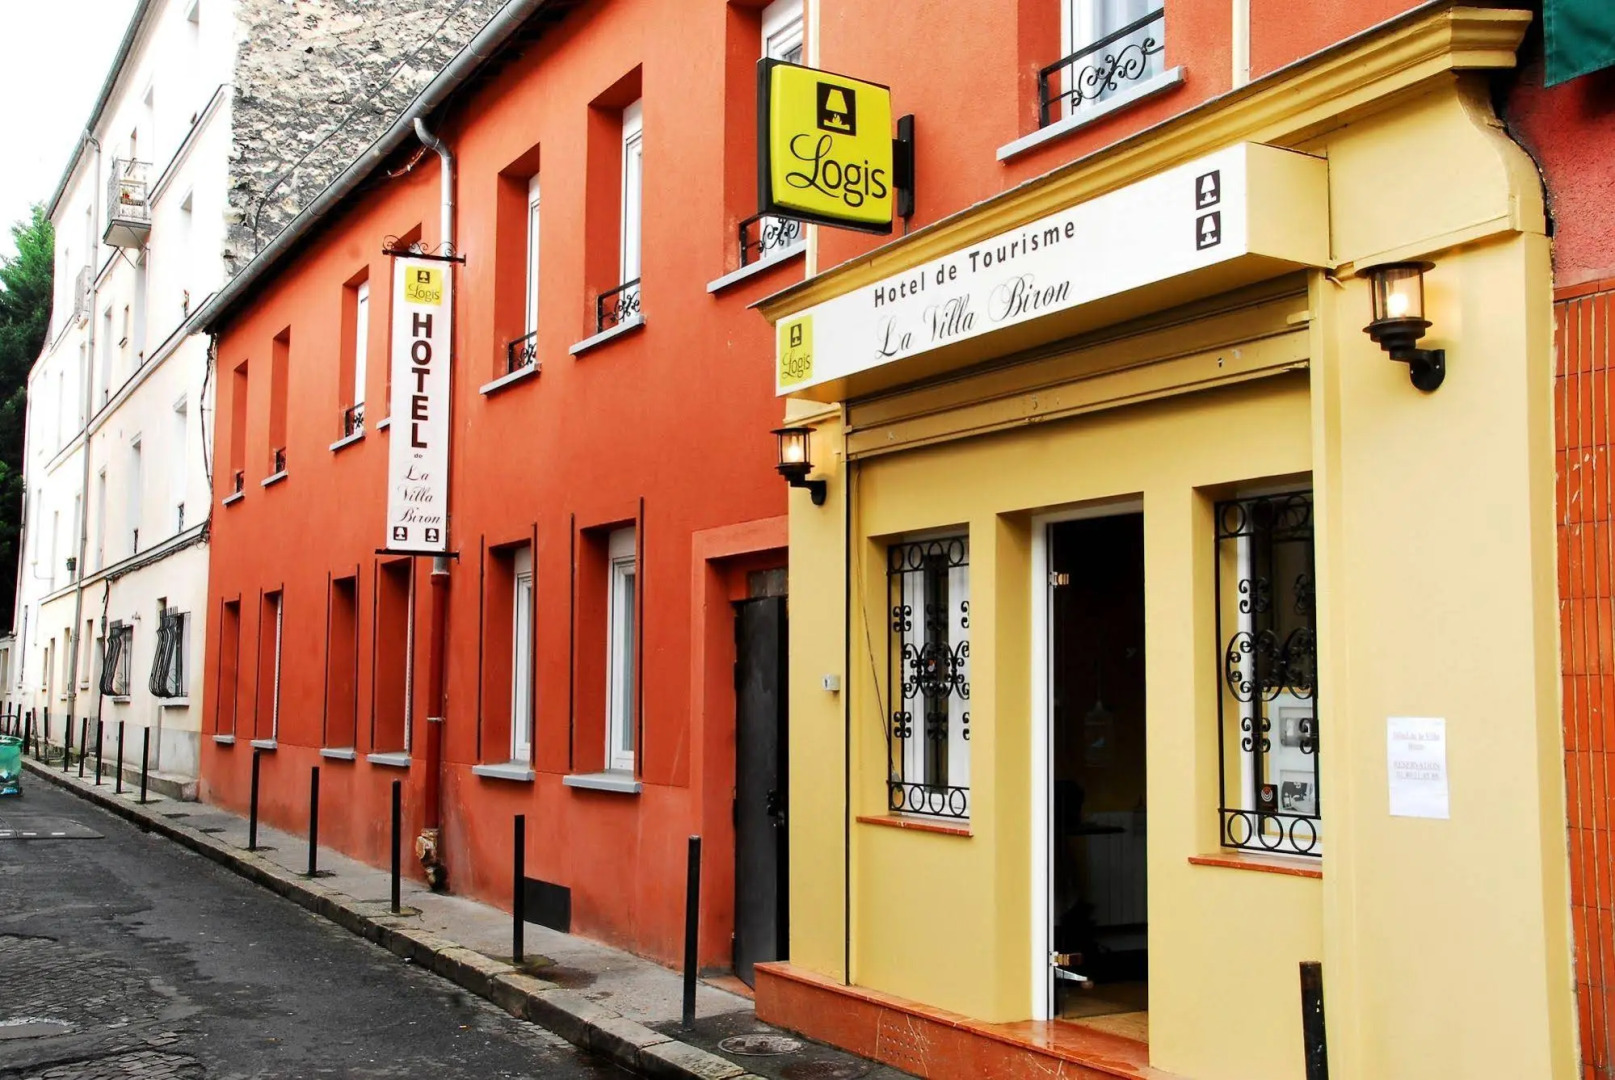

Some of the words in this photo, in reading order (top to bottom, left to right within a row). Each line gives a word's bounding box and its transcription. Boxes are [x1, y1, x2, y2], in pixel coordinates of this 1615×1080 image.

[785, 134, 887, 208] Logis
[874, 271, 925, 308] Hotel
[936, 264, 957, 285] de
[968, 221, 1075, 273] Tourisme
[408, 282, 440, 303] Logis
[875, 315, 914, 359] La
[922, 293, 976, 342] Villa
[988, 273, 1072, 322] Biron
[781, 349, 811, 379] Logis
[410, 312, 433, 449] HOTEL
[404, 464, 429, 481] La
[397, 486, 433, 503] Villa
[399, 506, 441, 524] Biron
